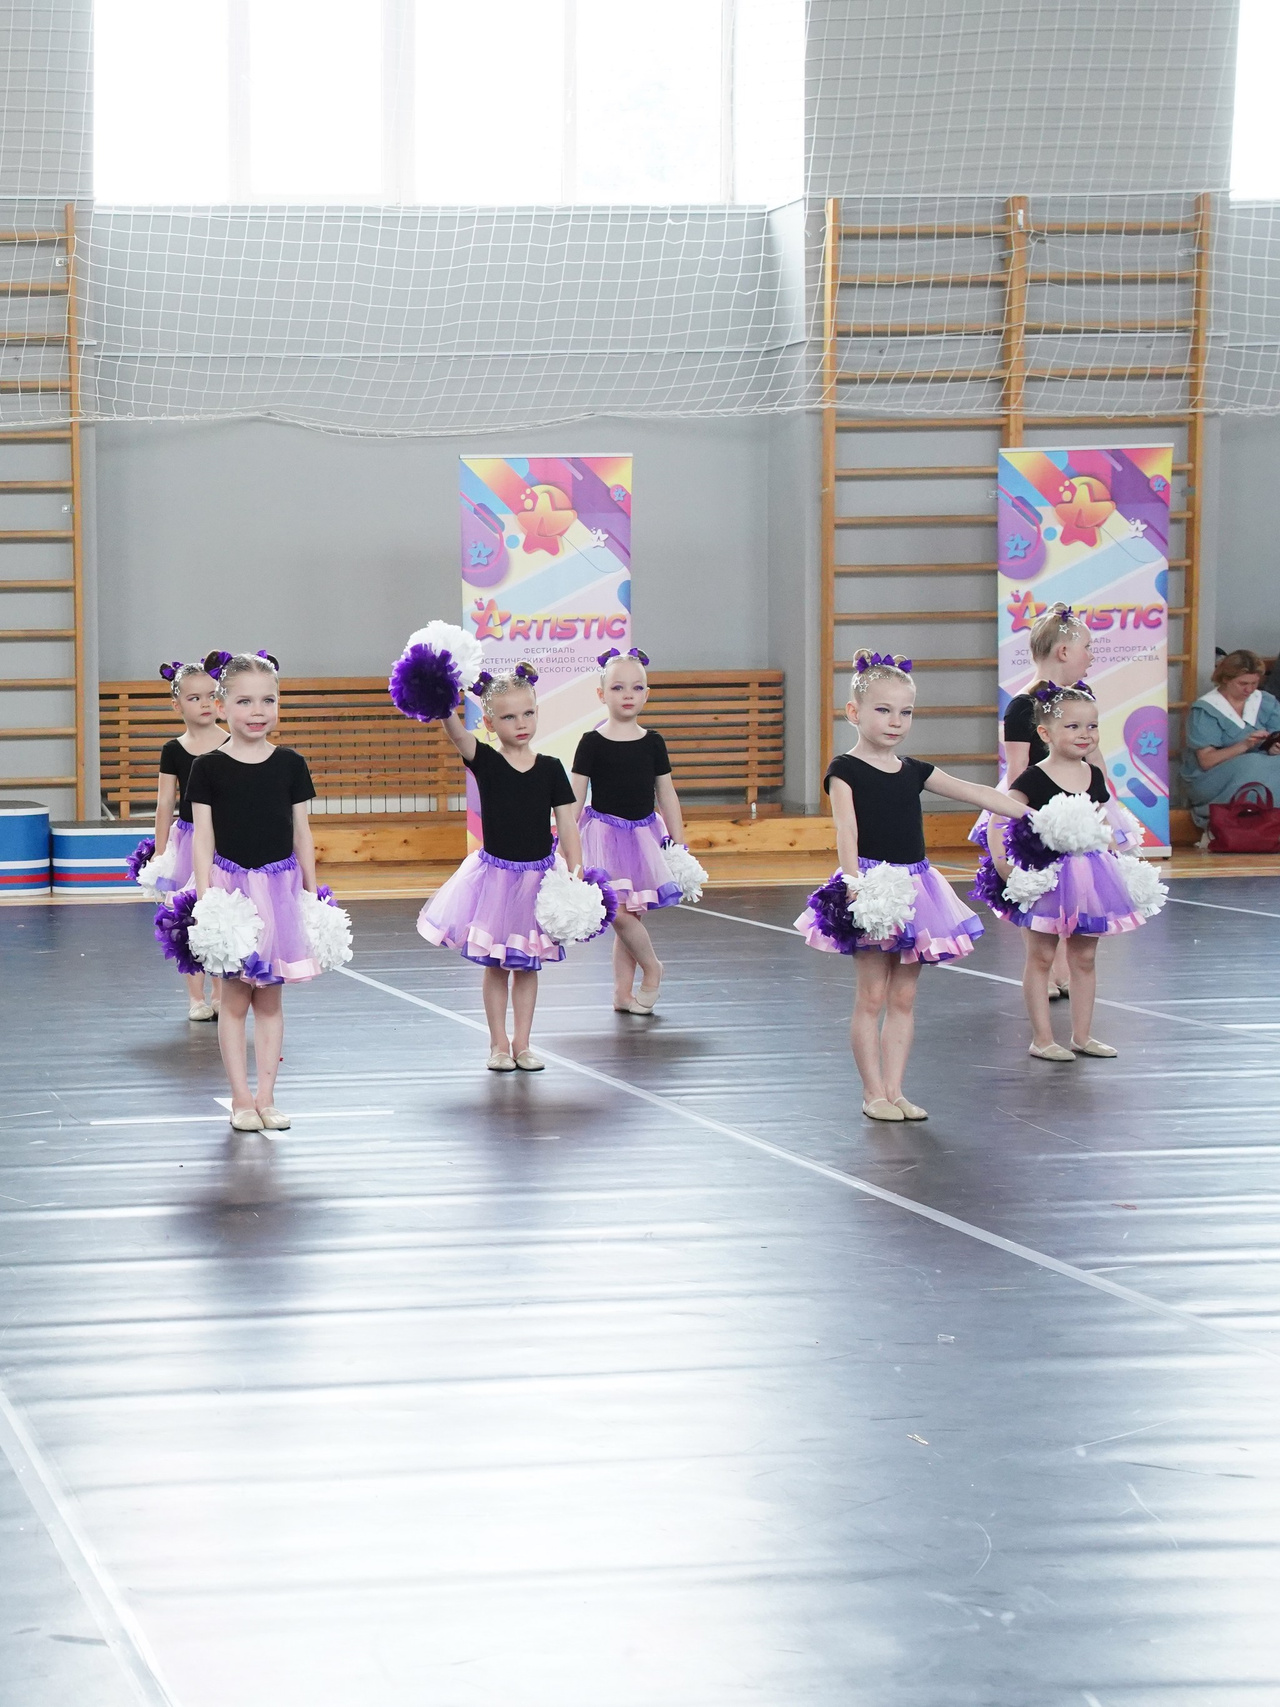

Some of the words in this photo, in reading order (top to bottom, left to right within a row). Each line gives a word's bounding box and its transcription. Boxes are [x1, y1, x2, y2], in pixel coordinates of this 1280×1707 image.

[470, 598, 627, 640] ARTISTIC
[1007, 590, 1164, 632] ATISTIC
[546, 656, 576, 664] ВИДОВ
[1109, 654, 1160, 662] ИСКУССТВА
